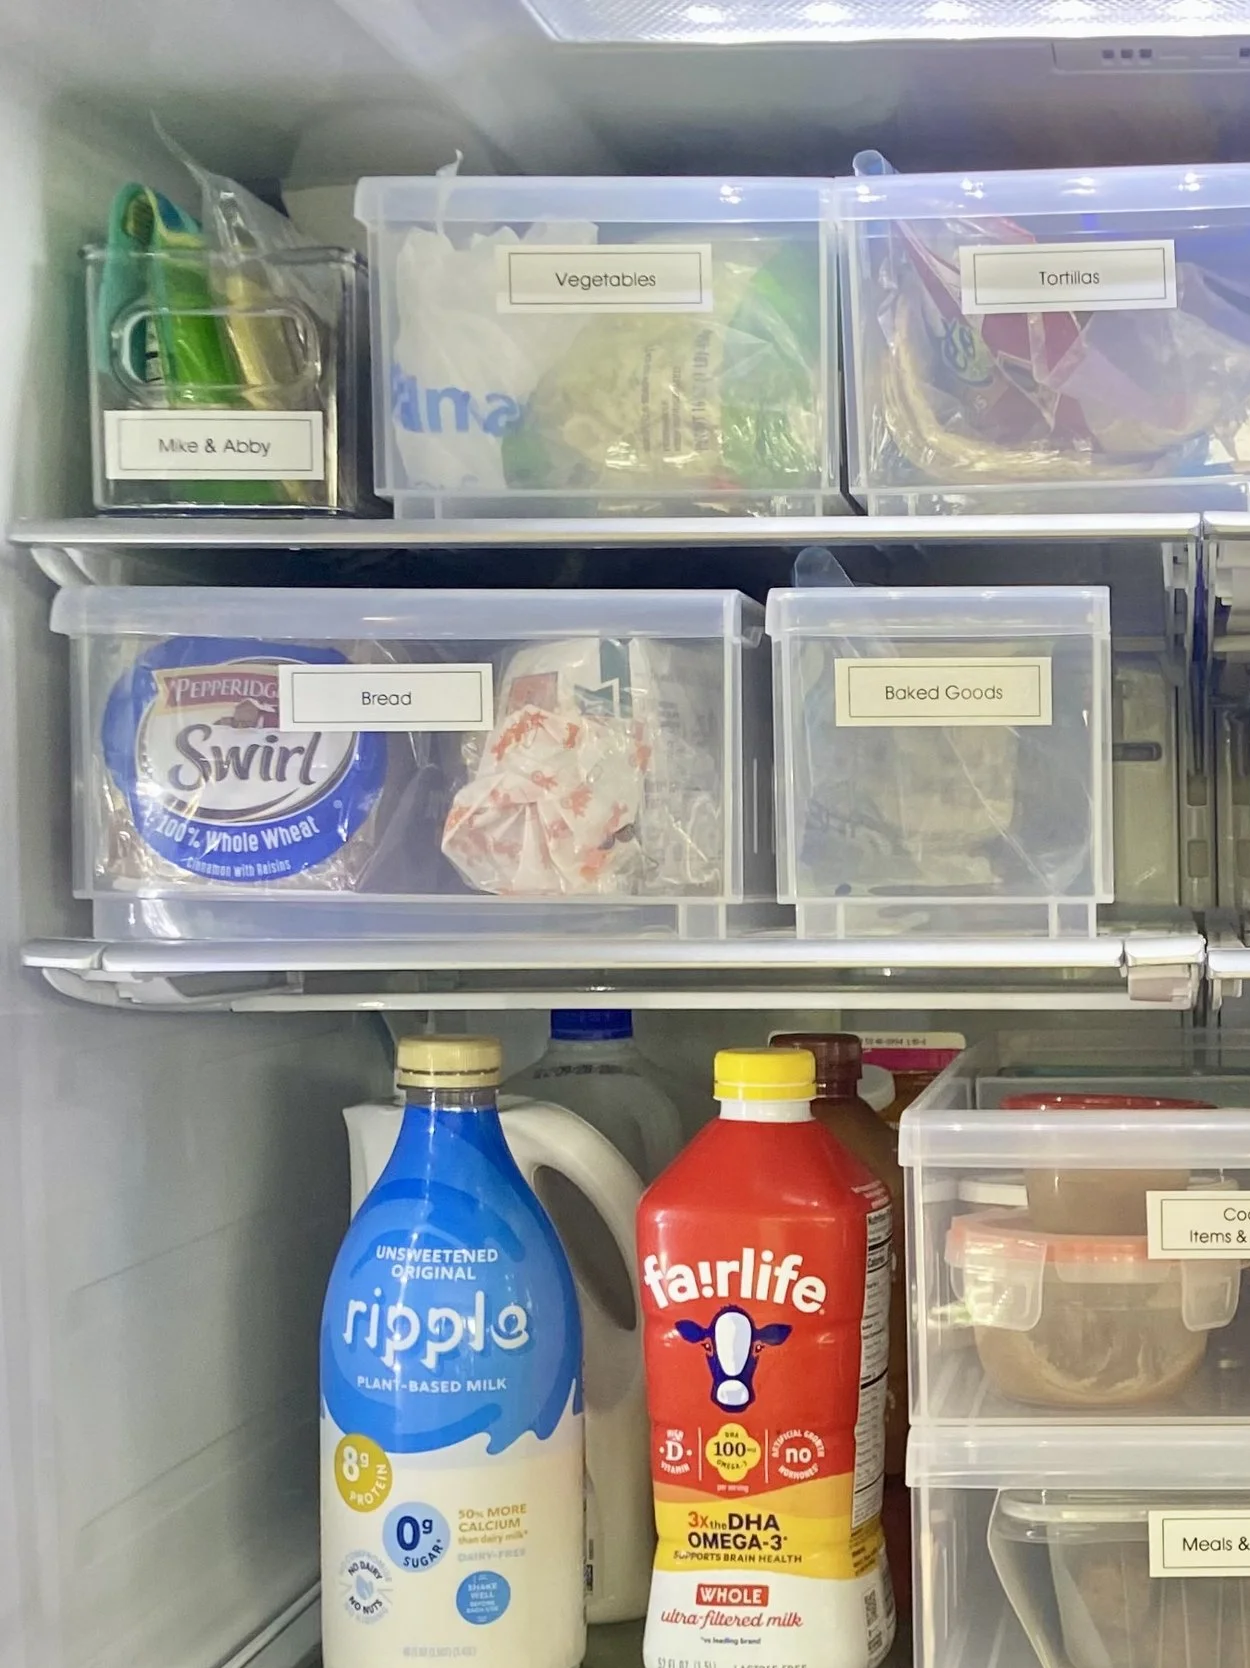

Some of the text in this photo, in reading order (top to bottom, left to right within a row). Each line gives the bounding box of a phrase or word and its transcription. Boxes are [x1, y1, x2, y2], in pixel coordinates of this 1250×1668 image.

[555, 271, 656, 290] Vegetables
[1039, 271, 1100, 285] Tortillas
[158, 438, 271, 457] Mike & Abby
[177, 678, 279, 699] PEPPERIDG
[885, 685, 1003, 700] Baked Goods
[361, 691, 412, 706] Bread
[167, 723, 322, 792] Swirl
[156, 815, 321, 853] 100% Whole Wheat
[233, 863, 255, 877] with
[1190, 1230, 1232, 1244] Items
[1236, 1230, 1247, 1244] &
[376, 1245, 498, 1263] UNSWEETENED
[391, 1264, 476, 1281] ORIGINAL
[342, 1286, 530, 1370] ripple
[357, 1376, 507, 1393] PLANT-BASED MILK
[665, 1440, 684, 1461] D
[785, 1447, 812, 1464] no
[660, 1460, 691, 1475] VITAMIN
[349, 1463, 388, 1505] PROTEIN
[458, 1503, 527, 1519] 50% MORE
[458, 1518, 521, 1532] CALCIUM
[728, 1513, 780, 1531] DHA
[396, 1515, 433, 1551] 0g
[458, 1535, 479, 1545] than
[480, 1532, 503, 1546] dairy
[1182, 1537, 1233, 1551] Meals
[1238, 1537, 1250, 1551] &
[673, 1551, 802, 1564] SUPPORTS BRAIN HEALTH
[348, 1562, 359, 1576] NO
[360, 1561, 383, 1580] DAIRY
[470, 1591, 495, 1600] WELL
[700, 1586, 762, 1604] WHOLE
[349, 1596, 361, 1611] NO
[363, 1599, 383, 1615] NUTS
[660, 1608, 804, 1630] ultra-filtered milk
